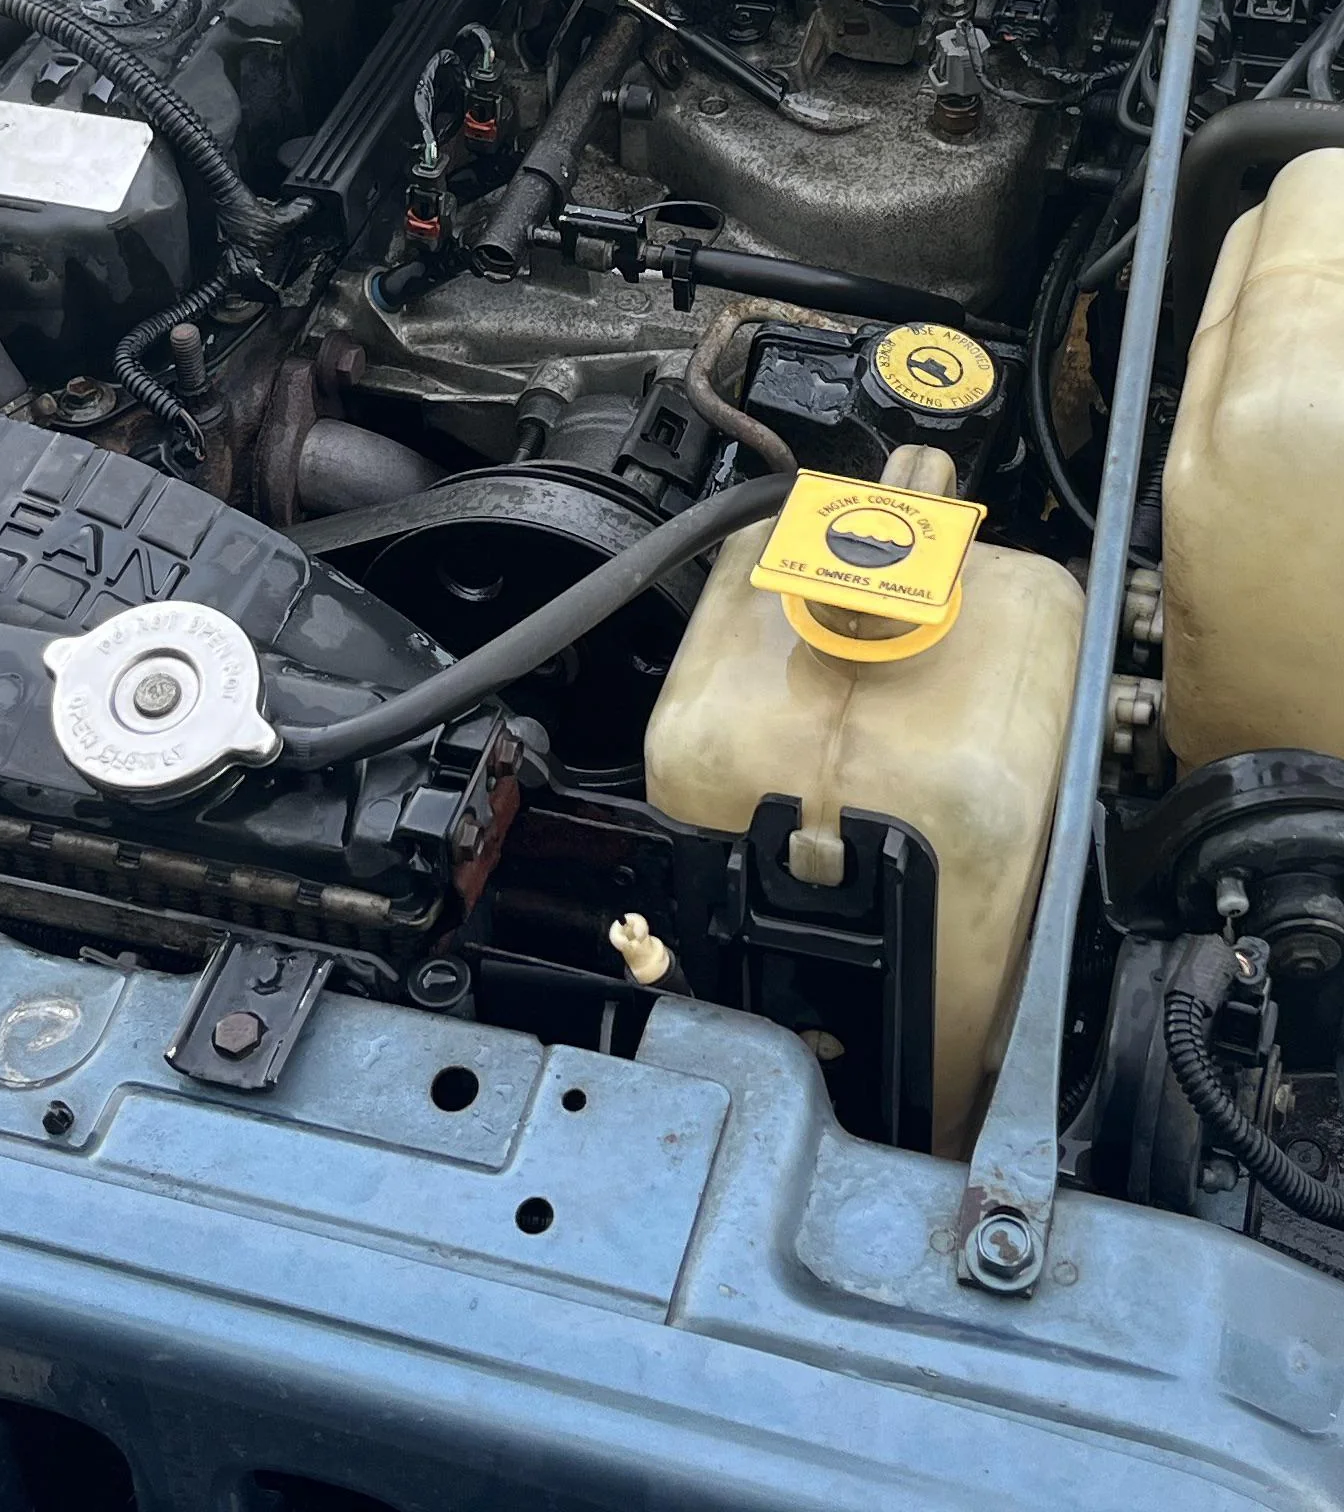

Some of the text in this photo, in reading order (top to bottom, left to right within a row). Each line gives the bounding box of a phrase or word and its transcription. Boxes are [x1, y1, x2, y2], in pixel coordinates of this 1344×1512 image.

[912, 326, 991, 371] USE APPROVED
[885, 373, 943, 408] STEERING
[950, 387, 985, 408] FLUID
[817, 495, 937, 541] ENGINE COOLANT ONLY
[779, 559, 935, 601] SEE OWNERS MANUAL
